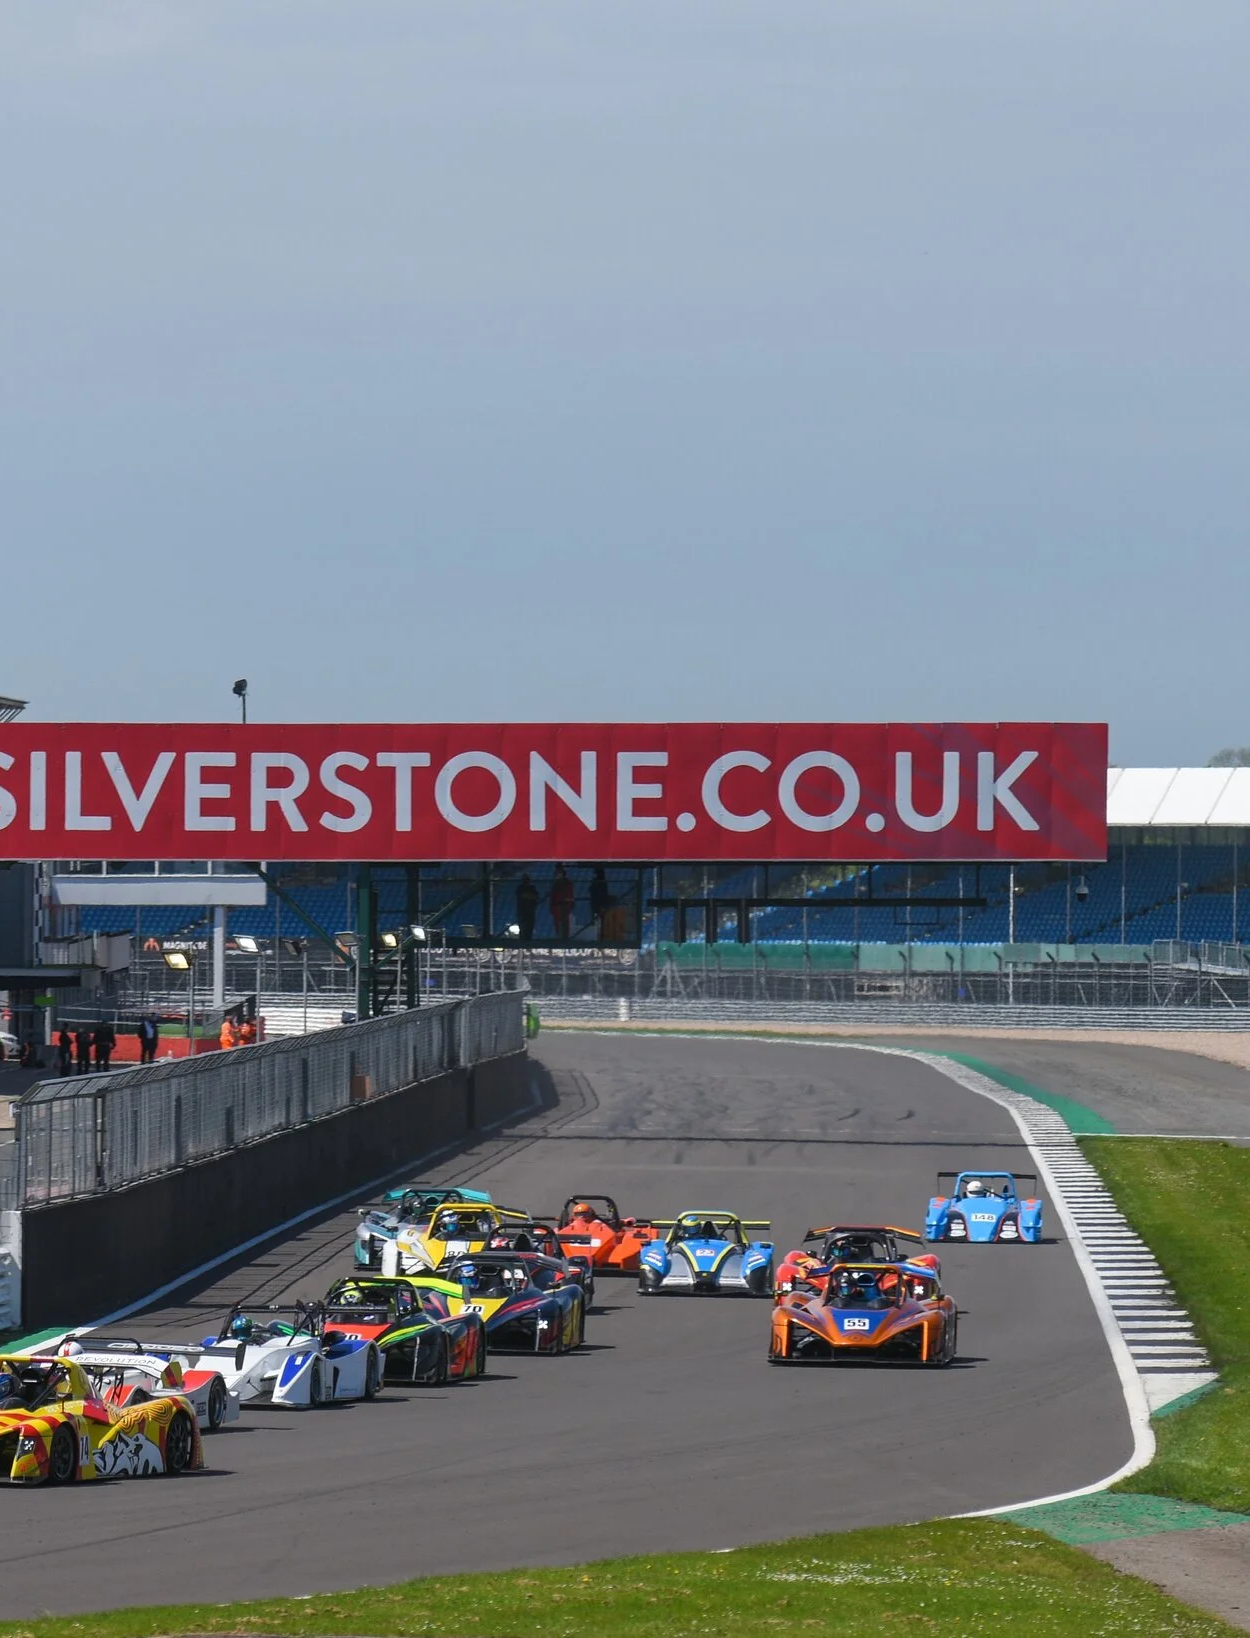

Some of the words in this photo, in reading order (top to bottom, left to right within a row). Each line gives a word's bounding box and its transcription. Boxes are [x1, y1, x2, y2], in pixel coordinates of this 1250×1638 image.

[463, 1305, 482, 1313] 70
[847, 1319, 866, 1327] 55
[75, 1356, 157, 1365] REVOLUTION
